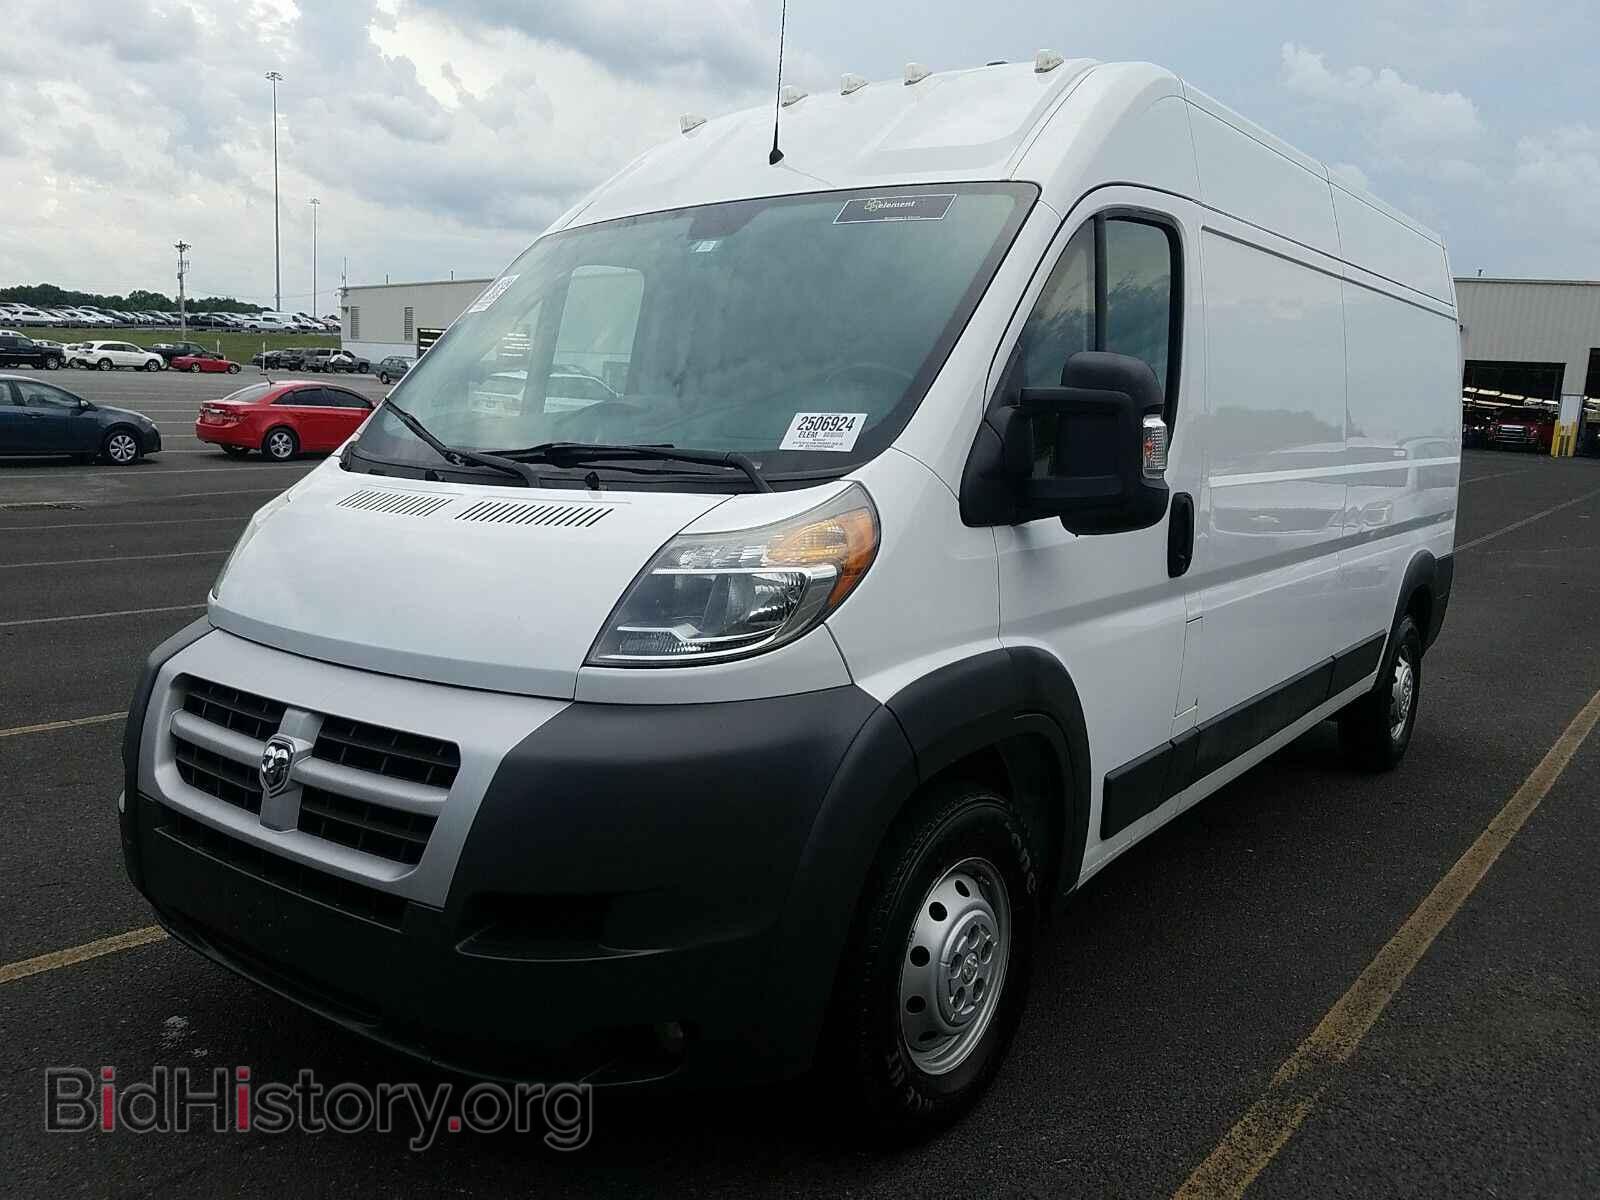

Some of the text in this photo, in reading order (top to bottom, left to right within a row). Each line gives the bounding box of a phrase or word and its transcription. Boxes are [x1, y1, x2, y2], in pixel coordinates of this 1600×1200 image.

[878, 201, 916, 210] element
[797, 415, 856, 432] 2506924
[798, 431, 818, 439] ELEM
